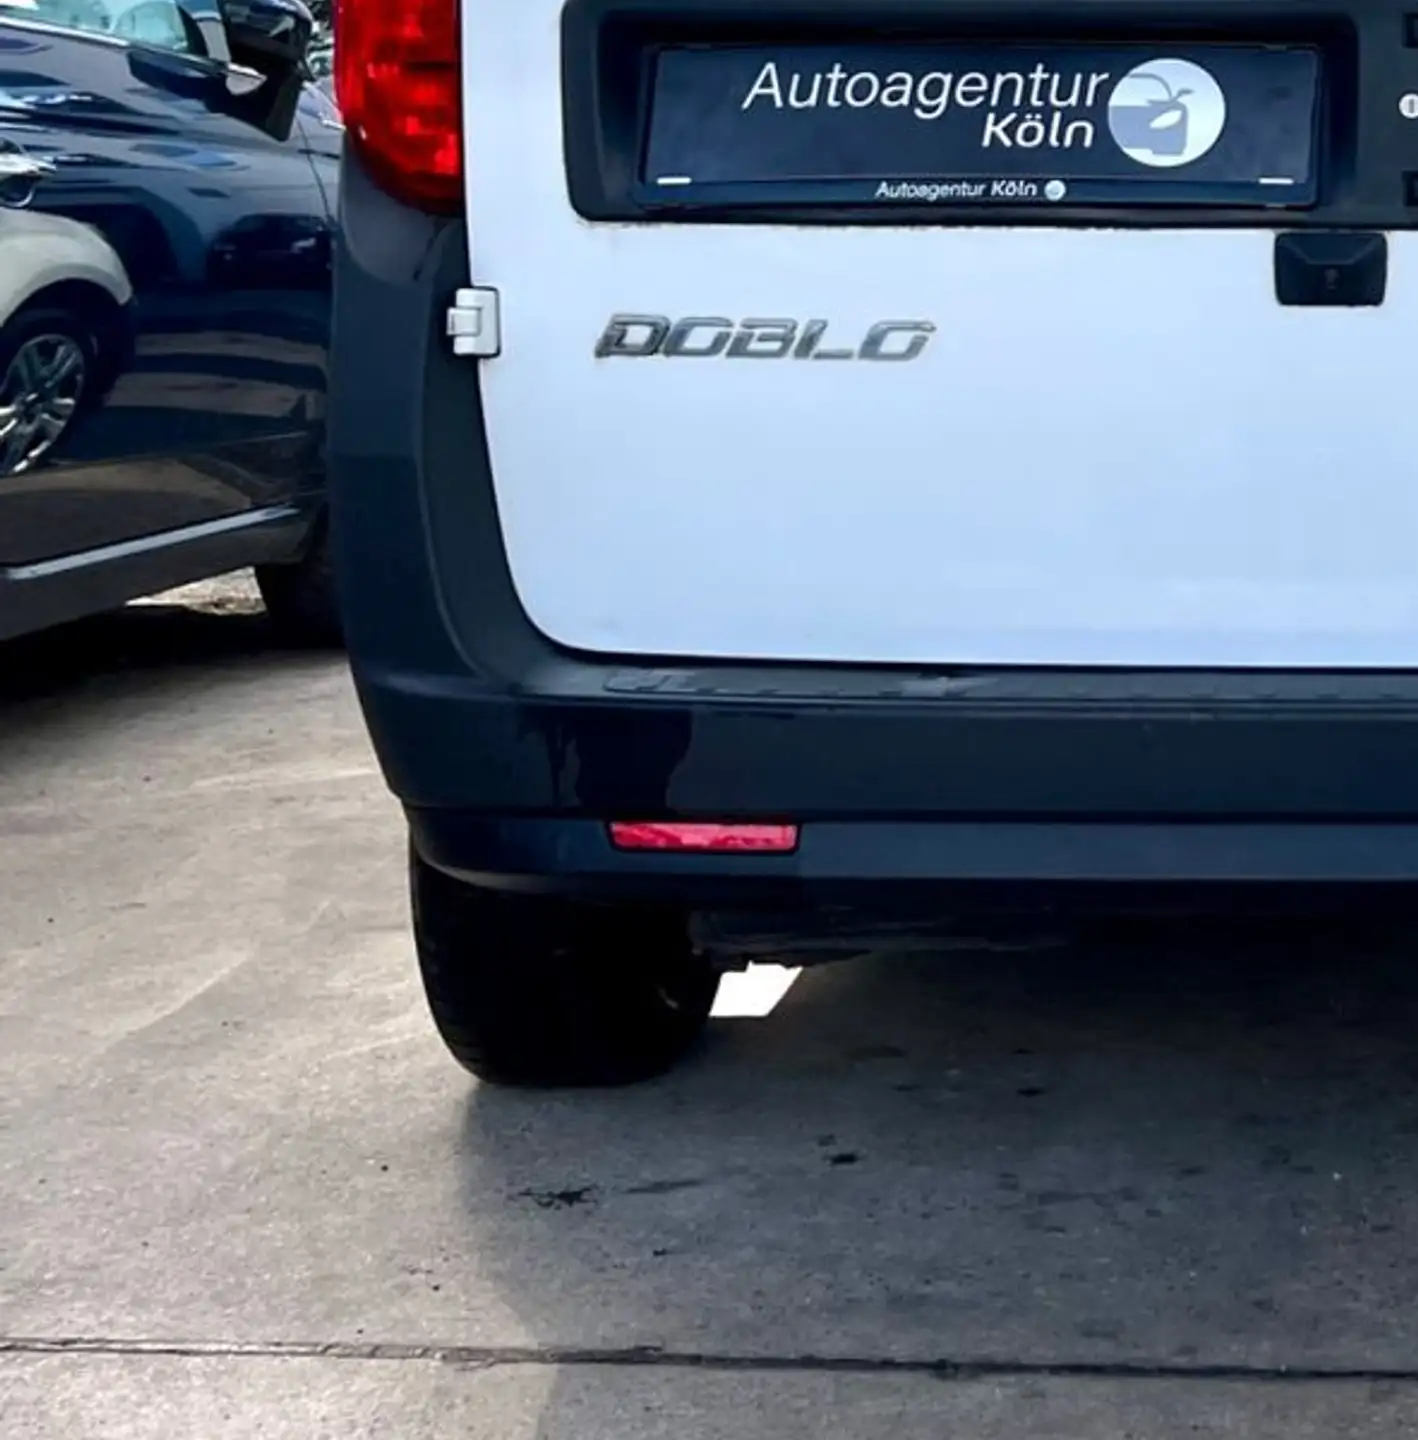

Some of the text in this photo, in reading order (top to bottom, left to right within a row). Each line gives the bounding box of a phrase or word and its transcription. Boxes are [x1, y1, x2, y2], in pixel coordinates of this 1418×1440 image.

[742, 61, 1109, 119] Autoagentur
[982, 111, 1094, 148] Köln
[875, 180, 1037, 201] Autoagentur Köln
